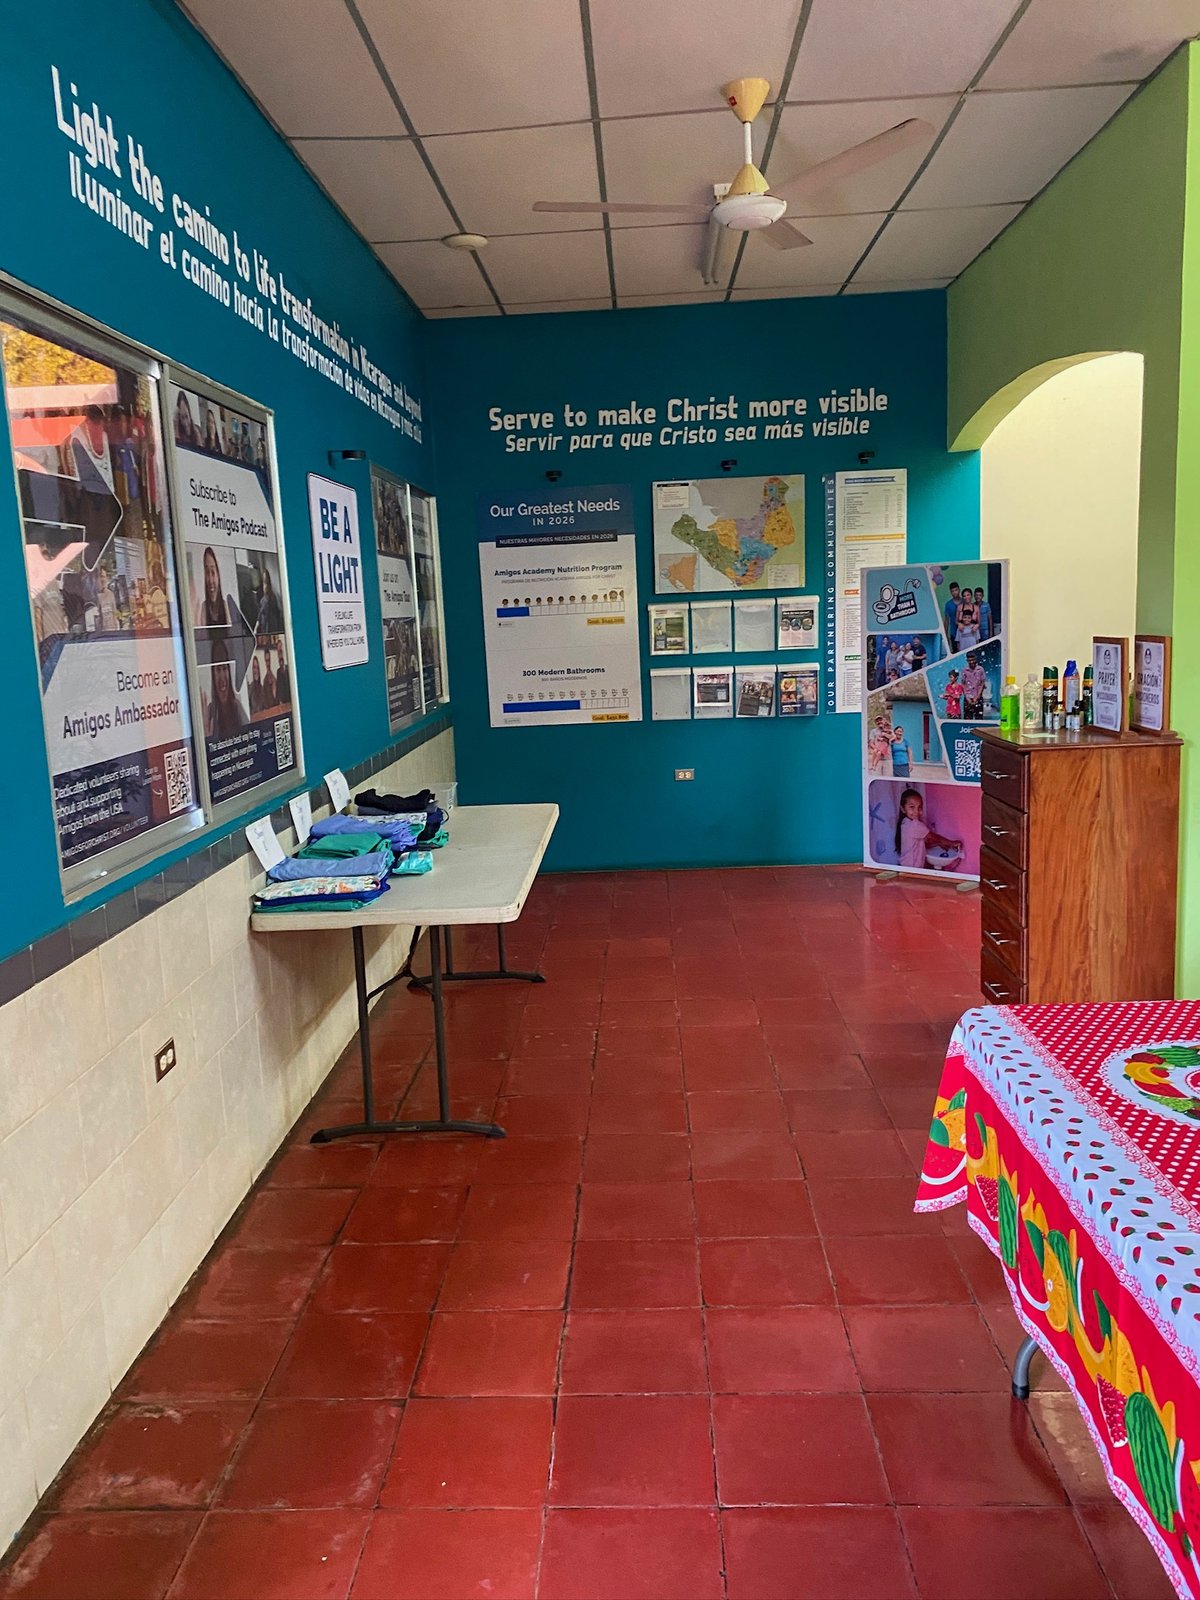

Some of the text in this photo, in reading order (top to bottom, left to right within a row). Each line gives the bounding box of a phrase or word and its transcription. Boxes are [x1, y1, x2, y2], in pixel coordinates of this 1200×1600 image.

[51, 65, 422, 422] Light the camino to life transformation in Nicaragua and beyond
[69, 151, 154, 250] Iluminar
[159, 230, 177, 270] el
[182, 249, 230, 307] camino
[233, 282, 264, 332] hacia
[267, 308, 279, 342] la
[281, 319, 344, 388] transformación
[344, 368, 354, 395] de
[353, 376, 370, 407] vidas
[370, 391, 378, 412] en
[377, 392, 401, 429] Nicaragua
[488, 387, 889, 431] Serve to make Christ more visible
[505, 416, 870, 453] Servir para que Cristo sea más visible
[189, 478, 237, 506] Subscribe to
[192, 507, 268, 538] The Amigos Podcast
[319, 498, 353, 543] BE A
[489, 498, 620, 518] Our Greatest Needs
[532, 516, 575, 526] IN 2026
[499, 537, 528, 545] NUESTRAS
[528, 536, 554, 544] MAYORES
[554, 534, 591, 543] NECESIDADES
[319, 552, 359, 594] LIGHT
[494, 564, 623, 577] Amigos Academy Nutrition Program
[827, 478, 835, 706] OUR PARTNERING COMMUNITIES
[897, 601, 911, 611] THAN
[890, 606, 916, 620] BATHROOM
[116, 669, 174, 692] Become an
[522, 667, 606, 677] 300 Modern Bathrooms
[1097, 671, 1117, 686] PRAYER
[63, 696, 179, 739] Amigos Ambassador
[53, 764, 140, 800] Dedicated volunteers sharing
[55, 787, 122, 819] about and supporting
[57, 802, 124, 835] Amigos from the USA
